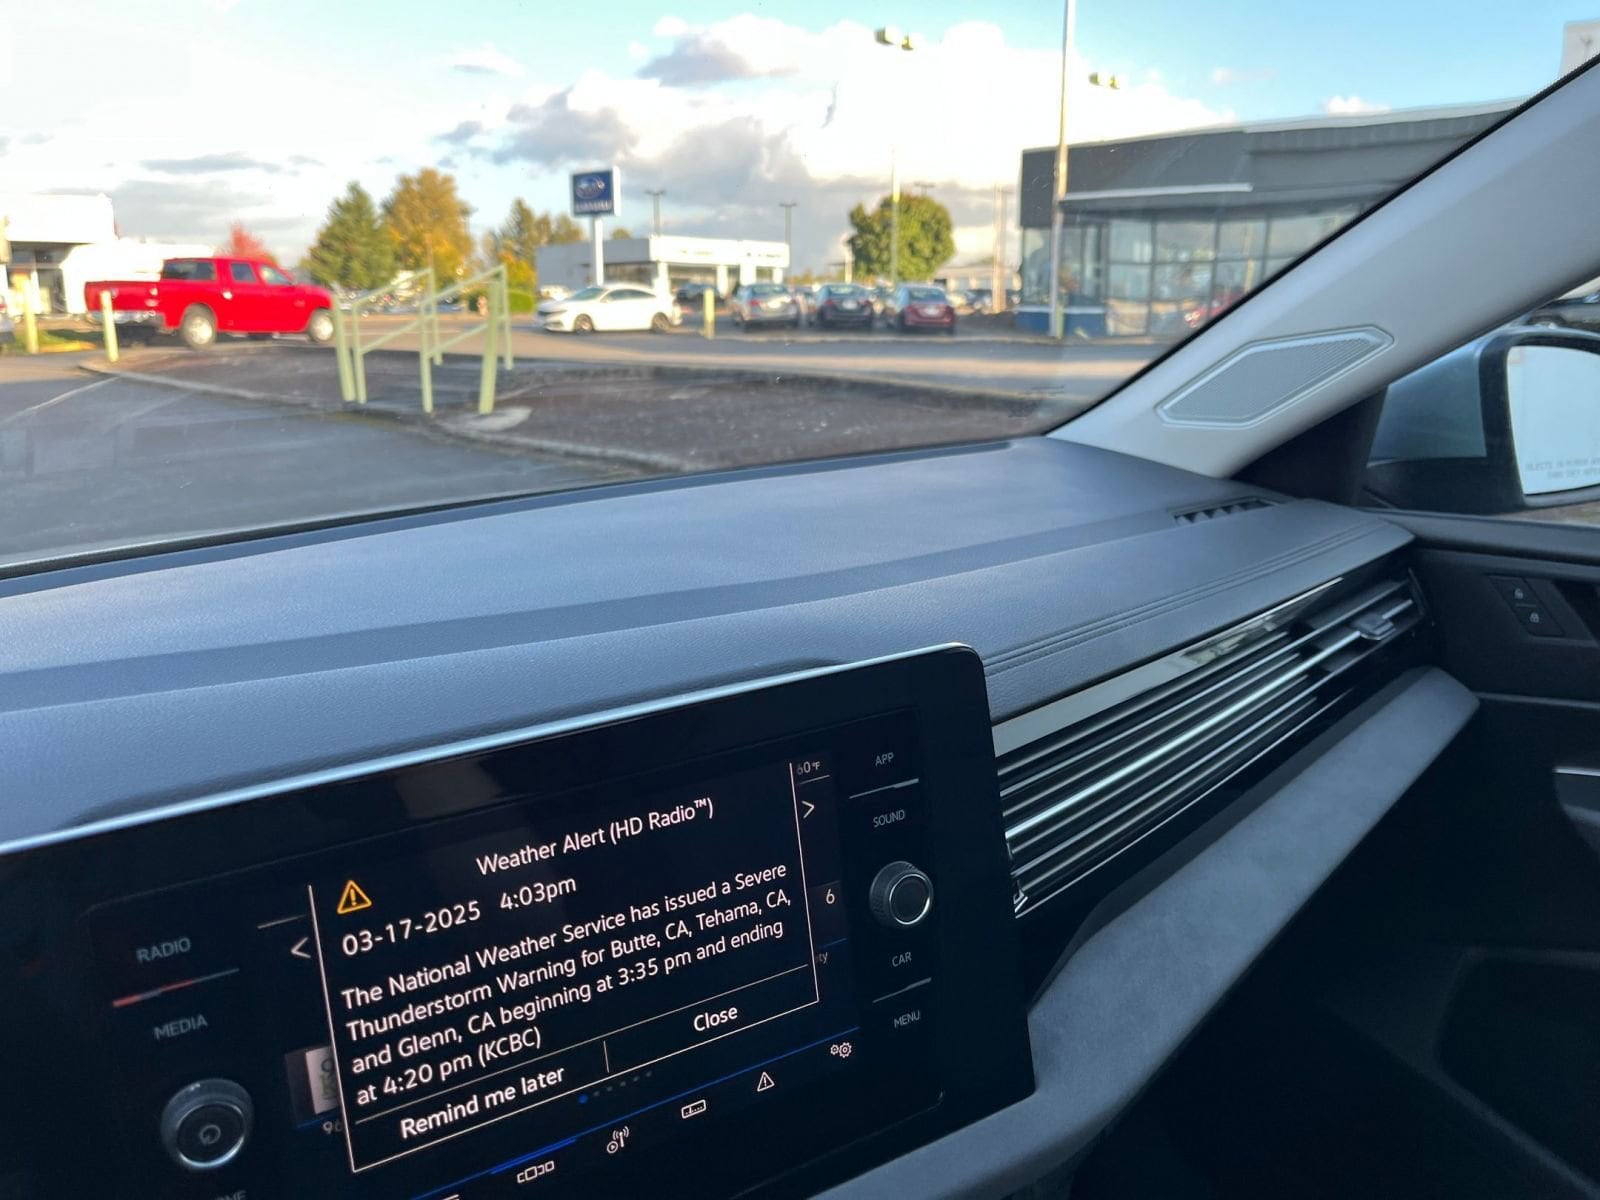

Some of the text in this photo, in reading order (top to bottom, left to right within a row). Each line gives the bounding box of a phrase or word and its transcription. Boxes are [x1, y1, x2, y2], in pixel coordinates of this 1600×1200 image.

[875, 752, 894, 767] APP
[873, 809, 905, 828] SOUND
[476, 842, 557, 875] Weather
[563, 828, 606, 854] Alert
[610, 817, 643, 845] (HD
[825, 889, 835, 904] 6
[342, 878, 576, 956] 03-17-2025 4:03pm
[136, 937, 191, 964] RADIO
[341, 865, 786, 1009] The National Weather Service has issued a Severe
[346, 889, 791, 1041] Thunderstorm Warning for Butte, CA, Tehama, CA,
[892, 952, 912, 967] CAR
[352, 922, 783, 1073] and Glenn, CA beginning at 3:35 pm and ending
[154, 1014, 208, 1041] MEDIA
[694, 1007, 738, 1031] Close
[894, 1011, 921, 1028] MENU
[357, 1026, 541, 1105] at 4:20 pm (KCBC)
[400, 1068, 564, 1139] Remind me later
